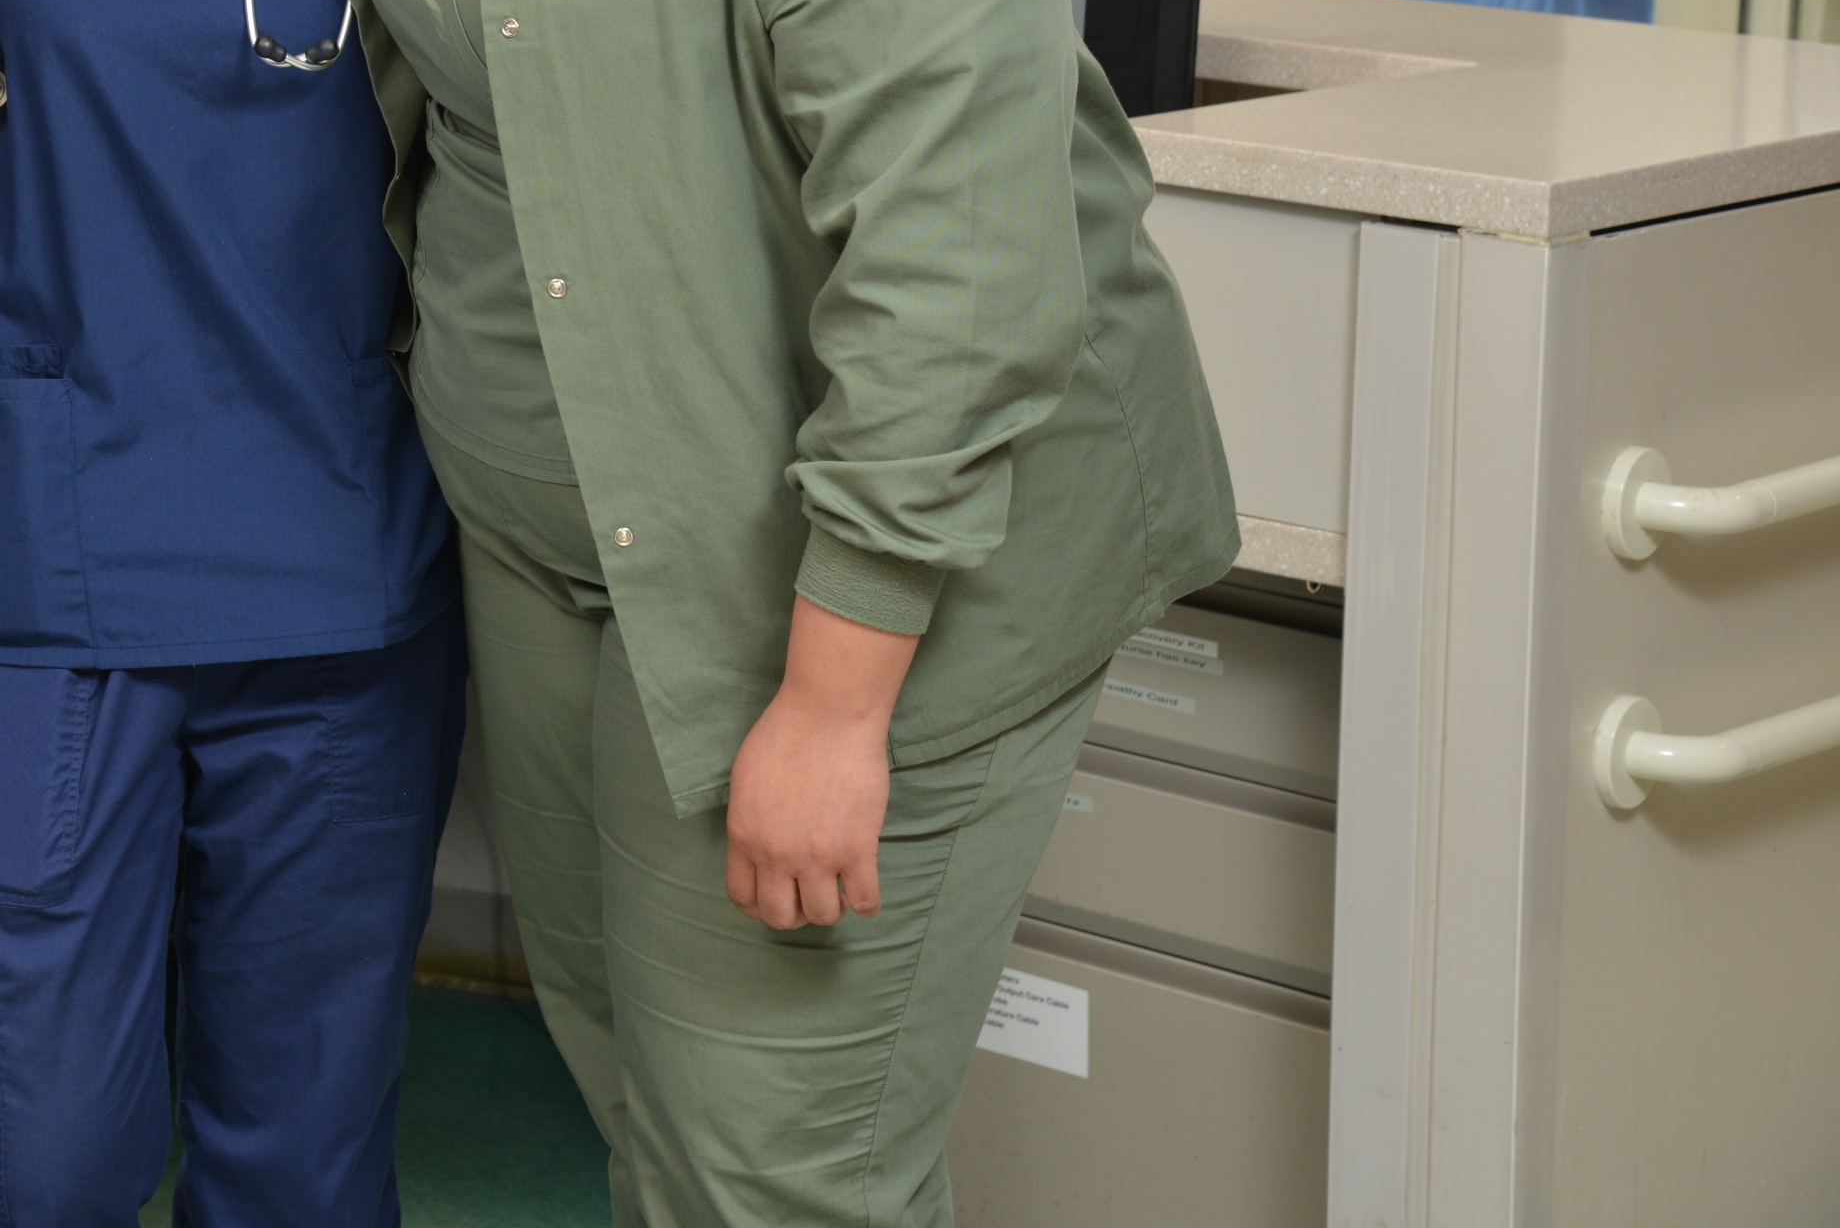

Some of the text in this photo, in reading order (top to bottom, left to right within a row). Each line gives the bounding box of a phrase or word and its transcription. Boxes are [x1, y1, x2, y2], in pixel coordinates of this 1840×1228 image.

[1188, 640, 1205, 651] Kit
[1156, 650, 1180, 663] has
[1183, 657, 1207, 669] key
[1146, 691, 1178, 707] Card
